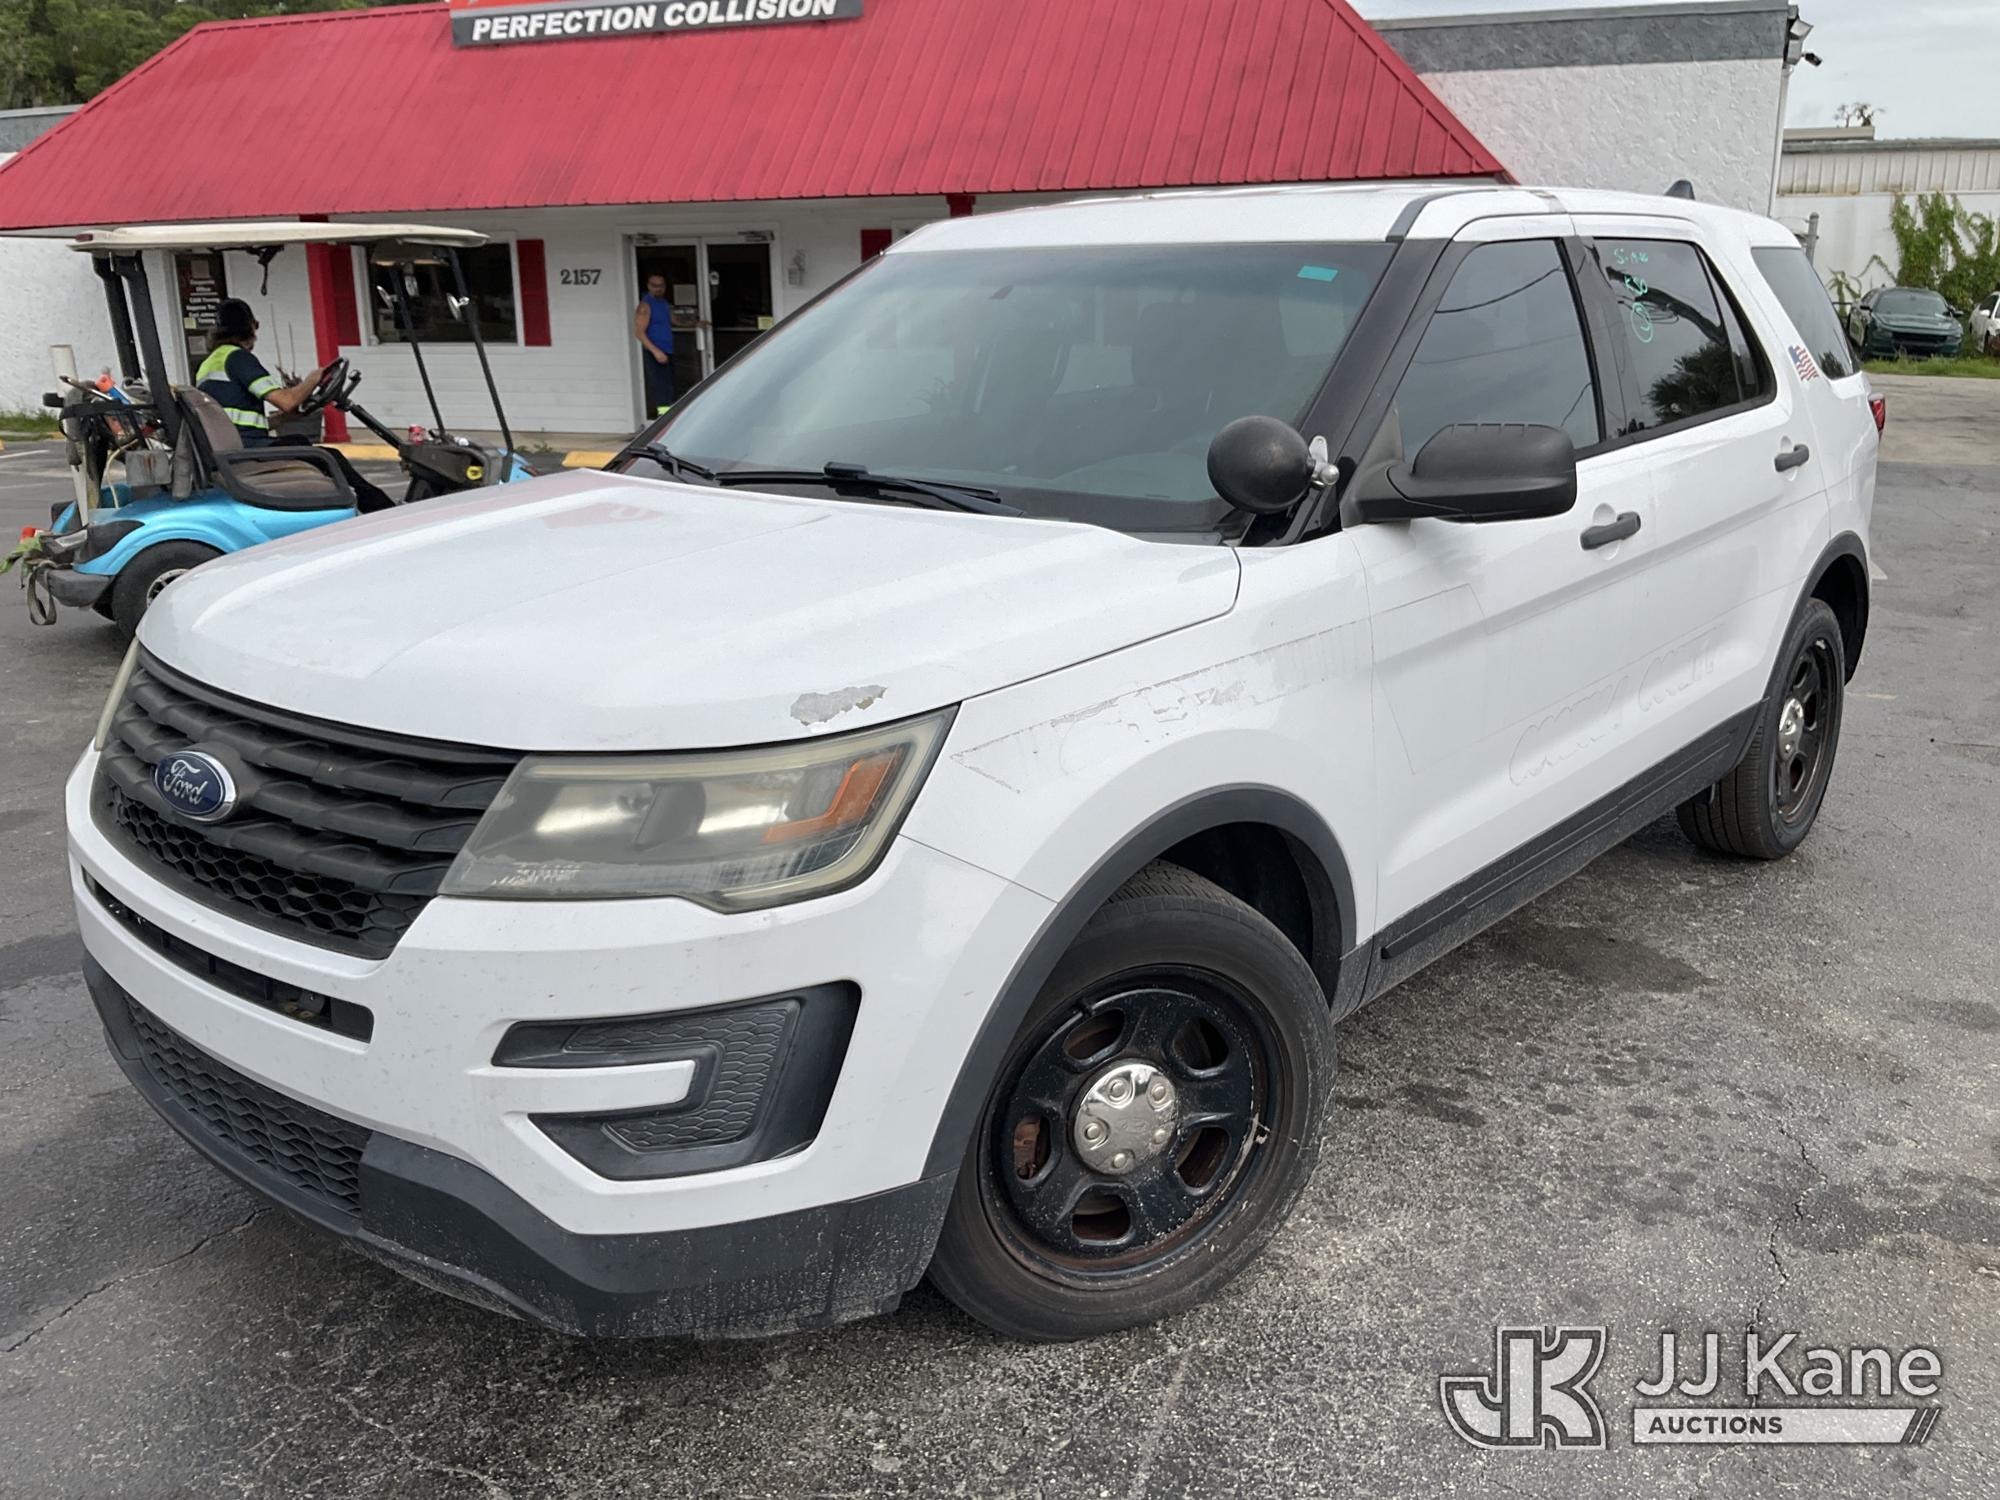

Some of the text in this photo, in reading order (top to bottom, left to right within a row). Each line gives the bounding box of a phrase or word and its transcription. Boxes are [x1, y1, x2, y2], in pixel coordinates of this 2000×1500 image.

[472, 0, 837, 41] PERFECTION COLLISION
[560, 268, 602, 286] 2157
[163, 759, 208, 805] Ford
